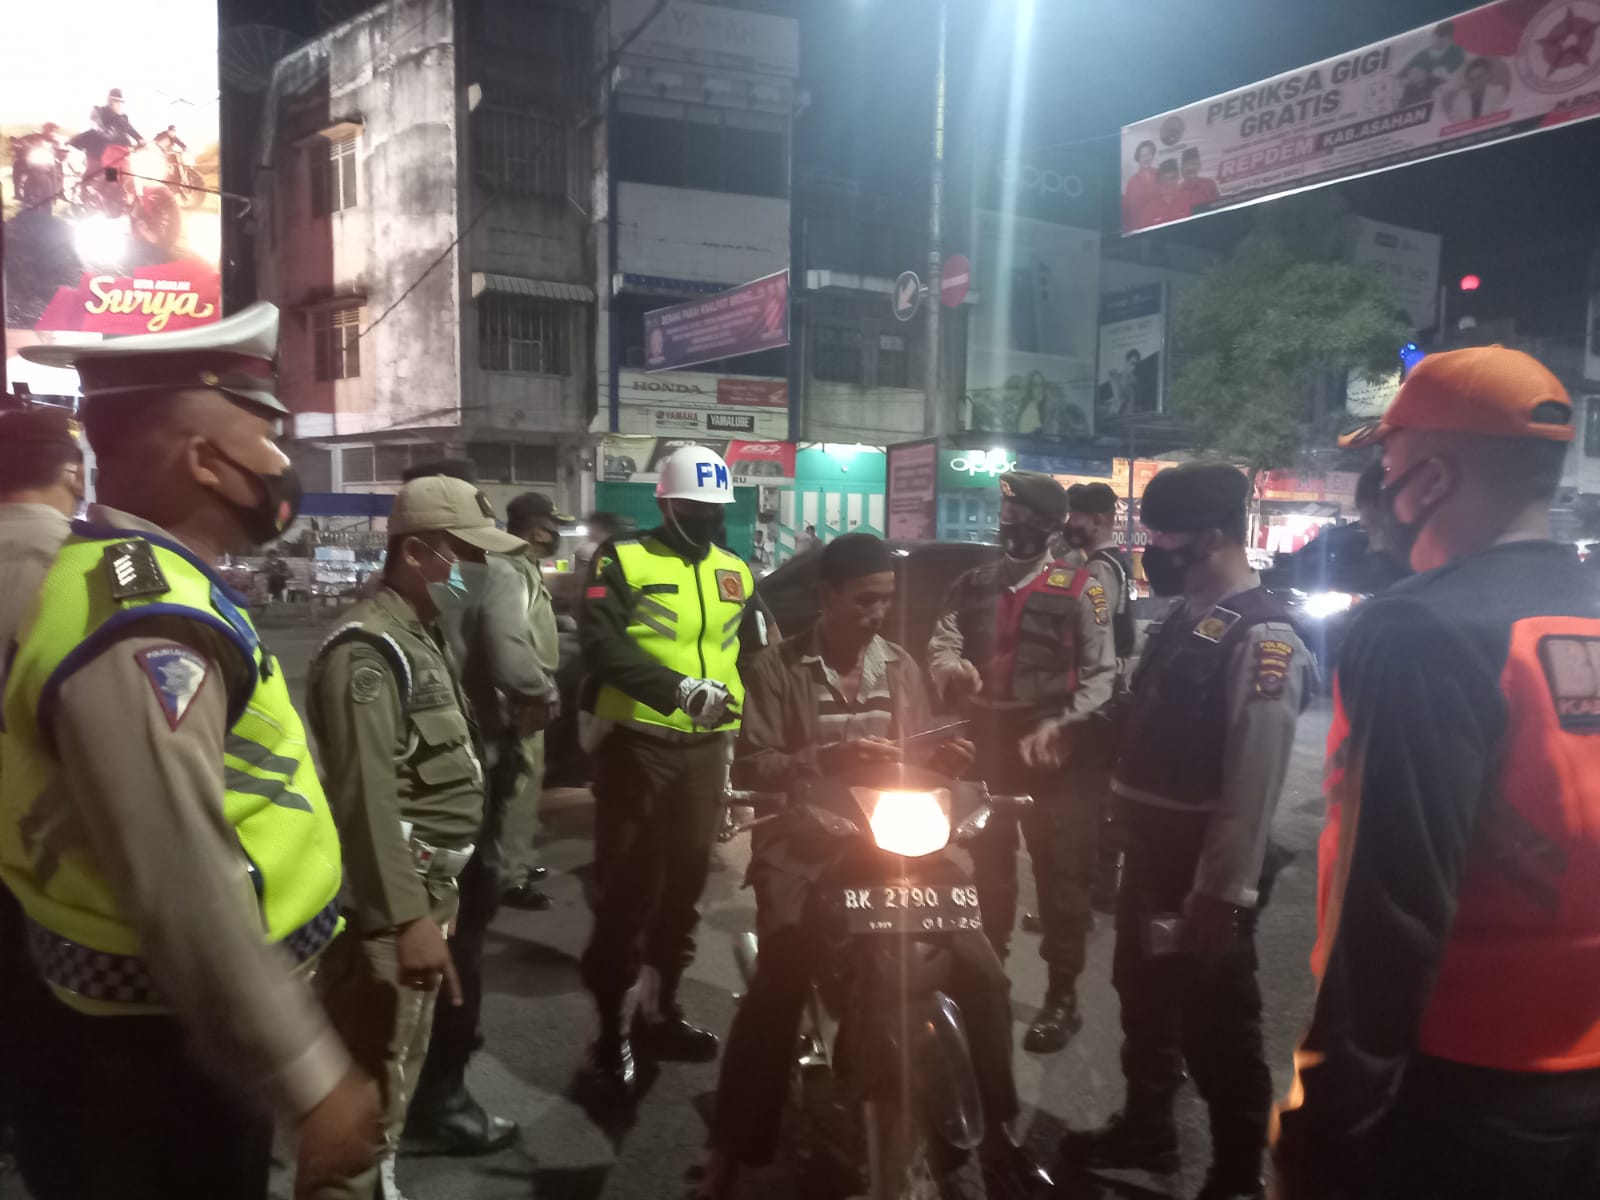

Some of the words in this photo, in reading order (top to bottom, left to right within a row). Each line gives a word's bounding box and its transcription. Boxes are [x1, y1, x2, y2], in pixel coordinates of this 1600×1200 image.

[1206, 69, 1322, 125] PERIKSA
[1330, 46, 1391, 84] GIGI
[1240, 88, 1342, 138] GRATIS
[1220, 137, 1314, 178] REPDEM
[997, 160, 1084, 199] ppo
[84, 276, 214, 332] Surya
[632, 381, 703, 394] HONDA
[665, 411, 698, 421] YAMAHA
[711, 415, 751, 428] YAMALUBE
[733, 476, 747, 484] RU
[844, 888, 873, 909] BK
